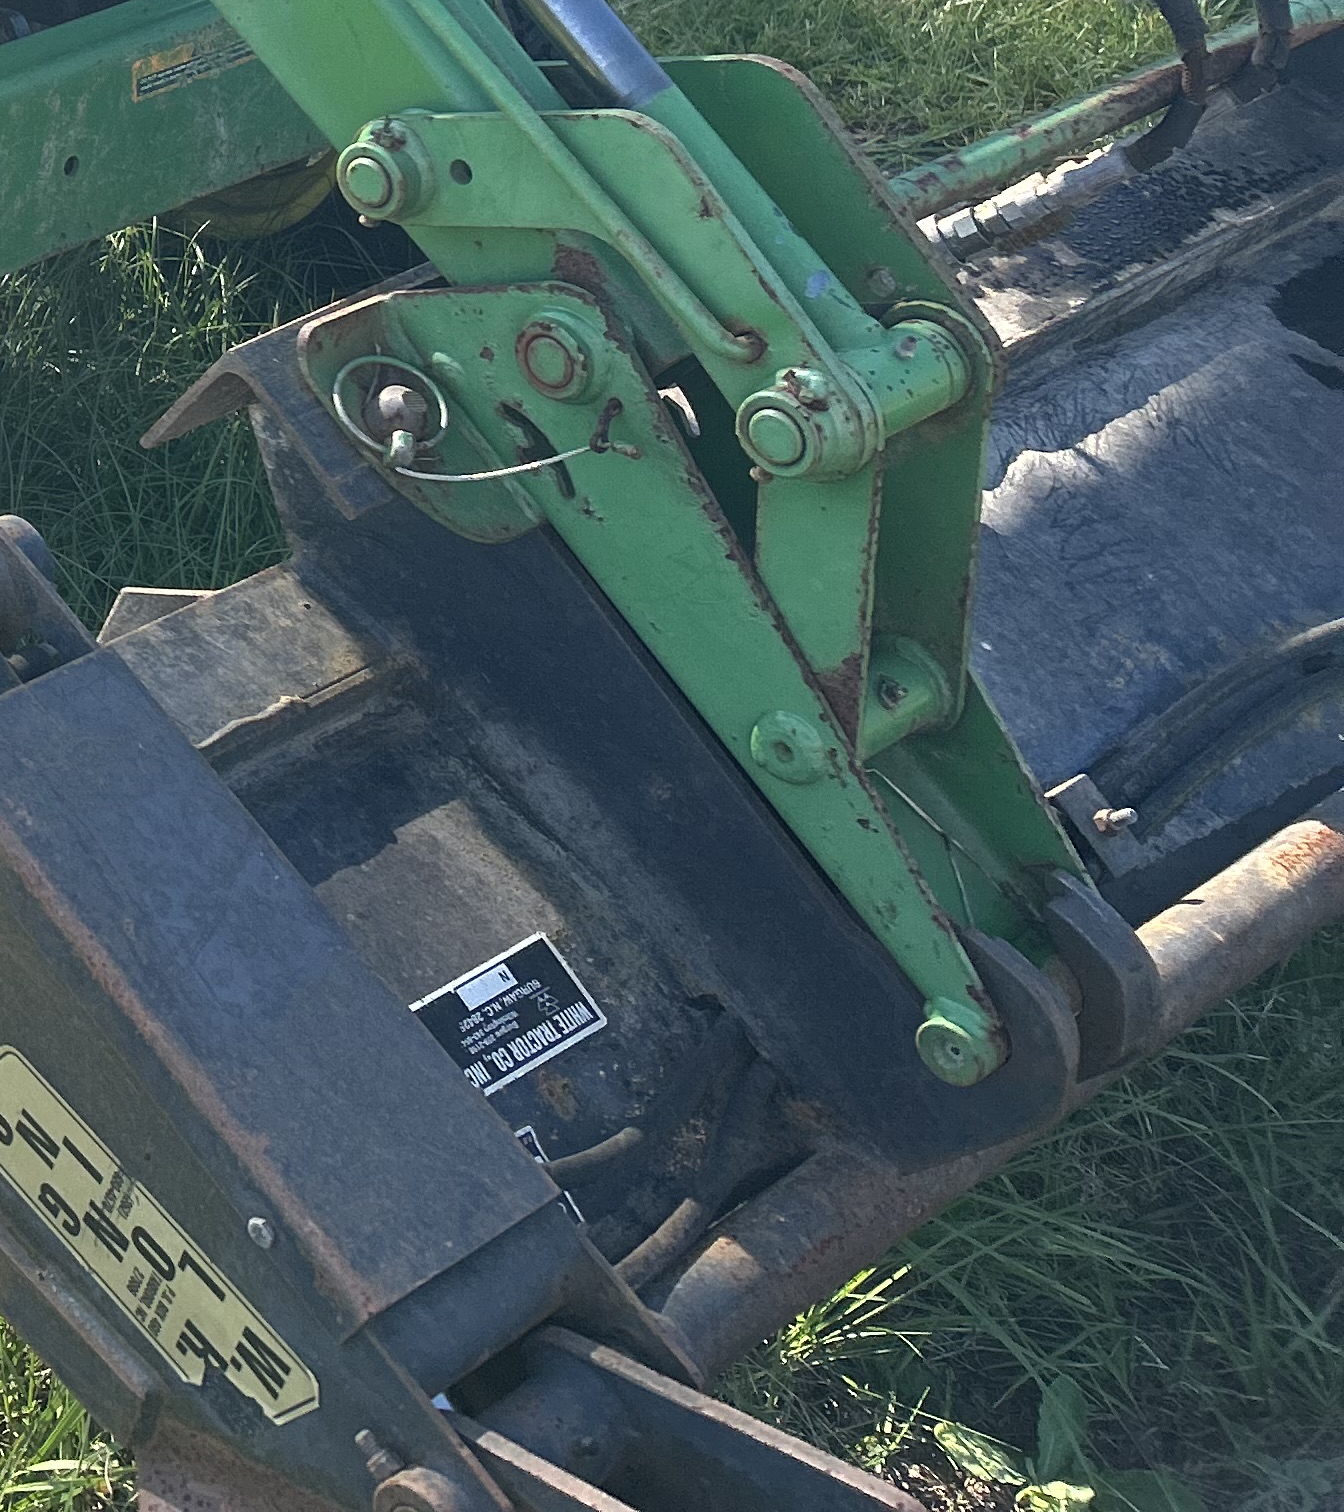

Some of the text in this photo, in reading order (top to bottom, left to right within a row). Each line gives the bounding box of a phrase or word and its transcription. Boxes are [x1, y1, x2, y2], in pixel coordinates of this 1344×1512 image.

[498, 969, 510, 983] N
[552, 1001, 594, 1035] WHITE
[506, 1019, 563, 1061] TRACTOR
[484, 1050, 516, 1073] CO.,
